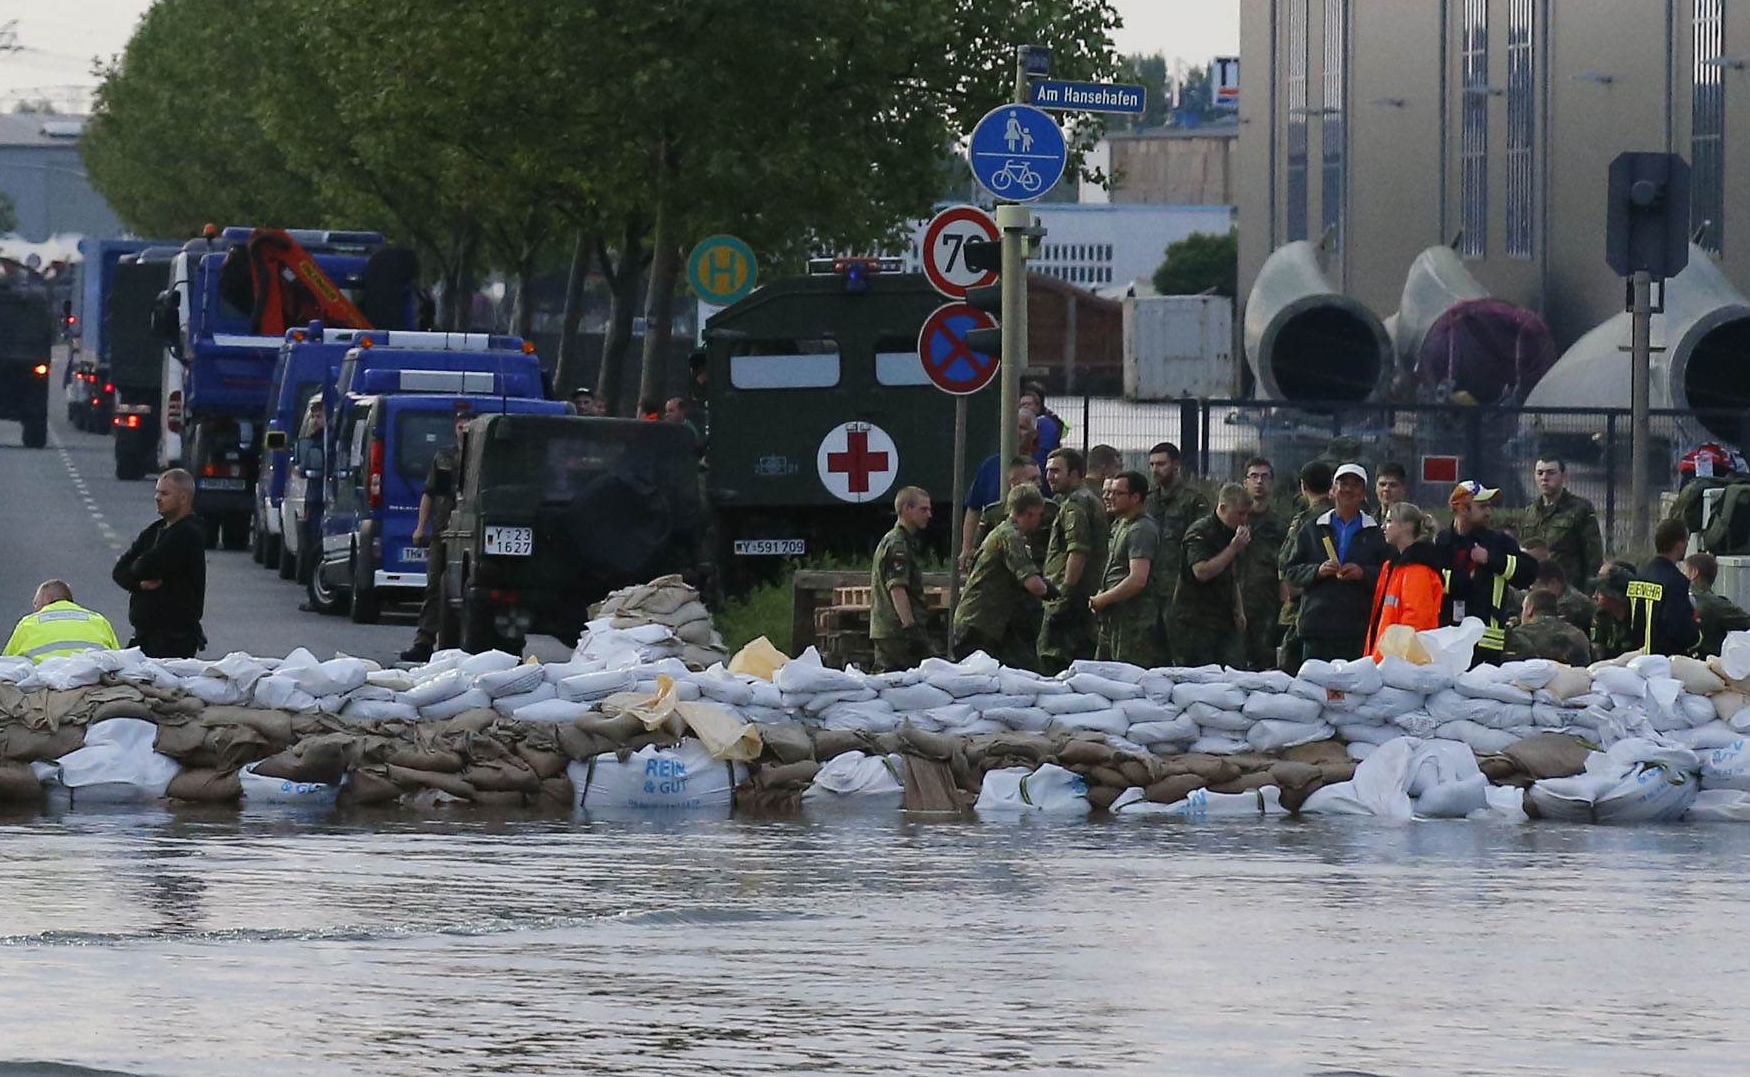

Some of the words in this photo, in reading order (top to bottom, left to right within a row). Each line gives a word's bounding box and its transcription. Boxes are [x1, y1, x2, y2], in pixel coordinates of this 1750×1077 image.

[1037, 85, 1059, 102] Am
[1064, 86, 1138, 106] Hansehafen
[497, 542, 531, 554] 1627
[645, 758, 687, 777] REIN
[643, 780, 655, 794] &
[660, 779, 687, 794] GUT
